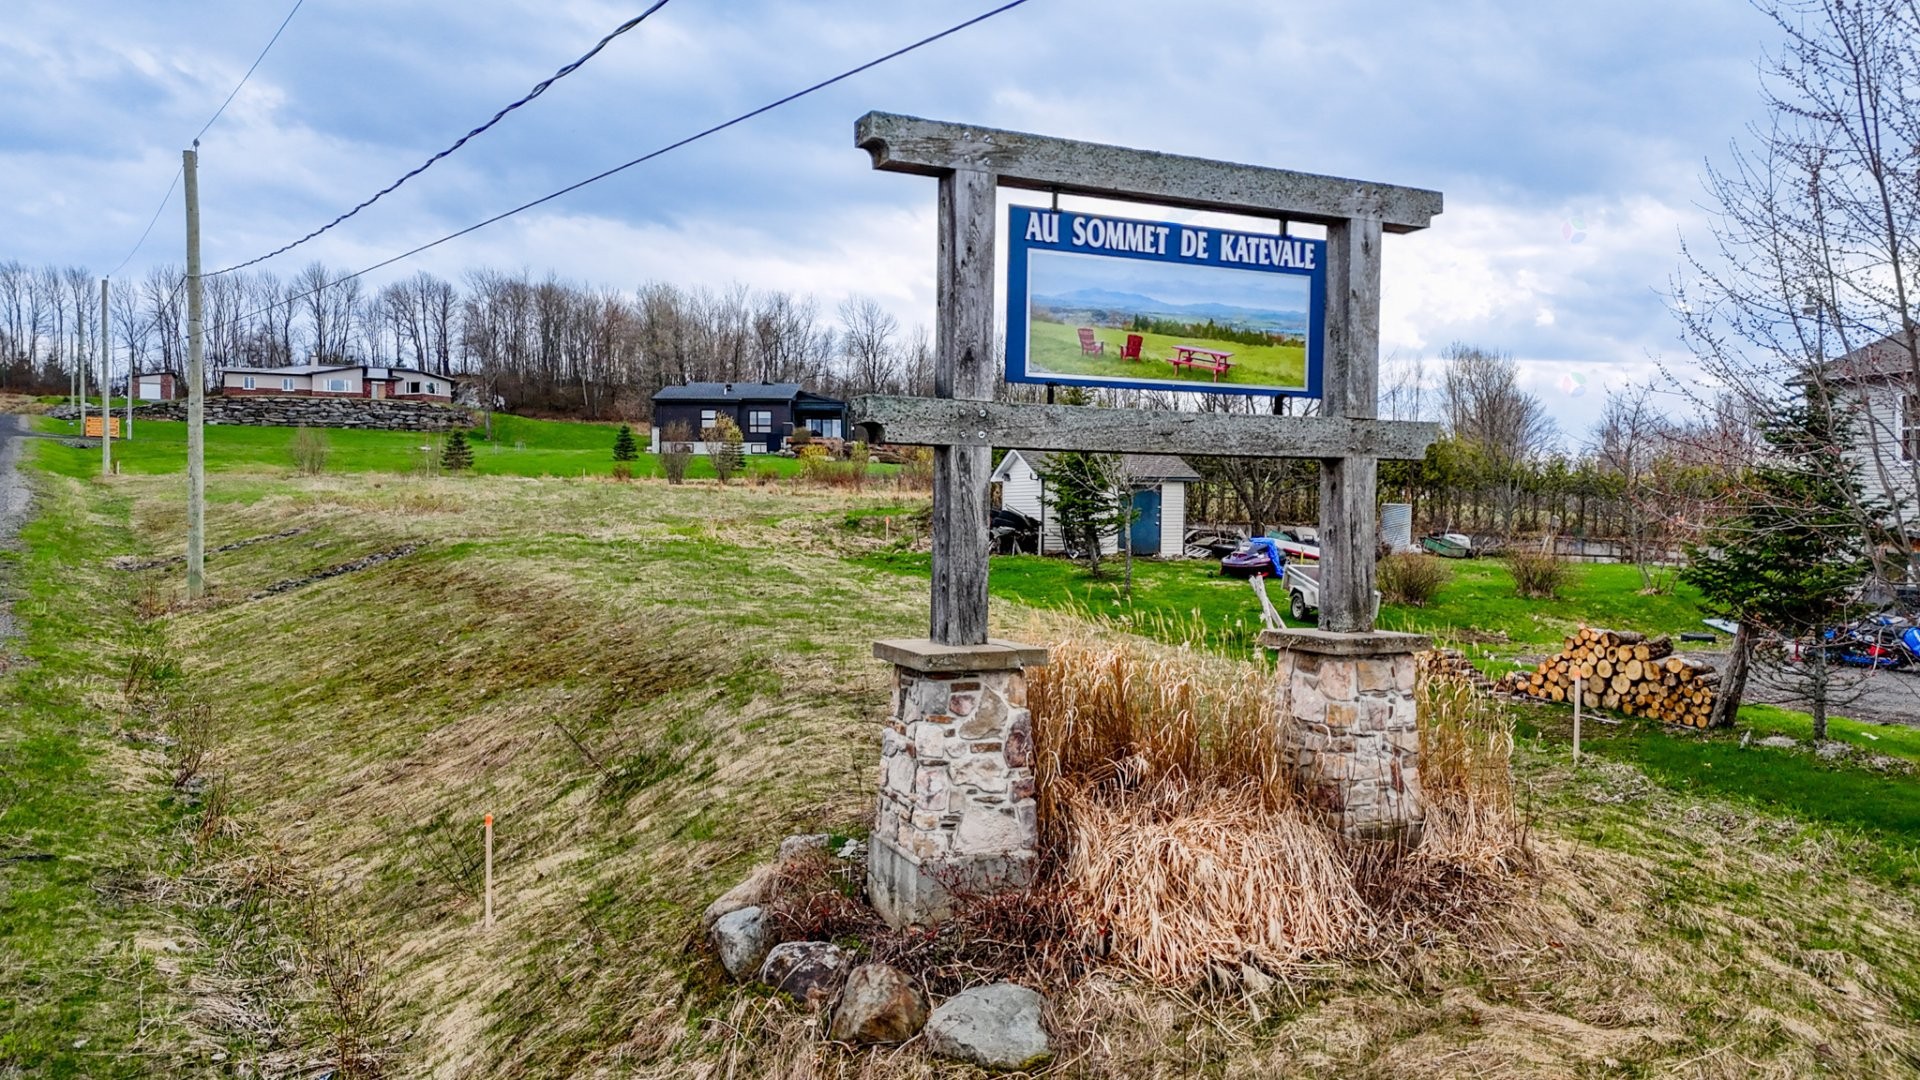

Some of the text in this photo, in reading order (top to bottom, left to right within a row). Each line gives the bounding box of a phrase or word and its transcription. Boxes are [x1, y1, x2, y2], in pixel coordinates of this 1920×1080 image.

[1025, 212, 1316, 270] AU SOMMET DE KATEVALE
